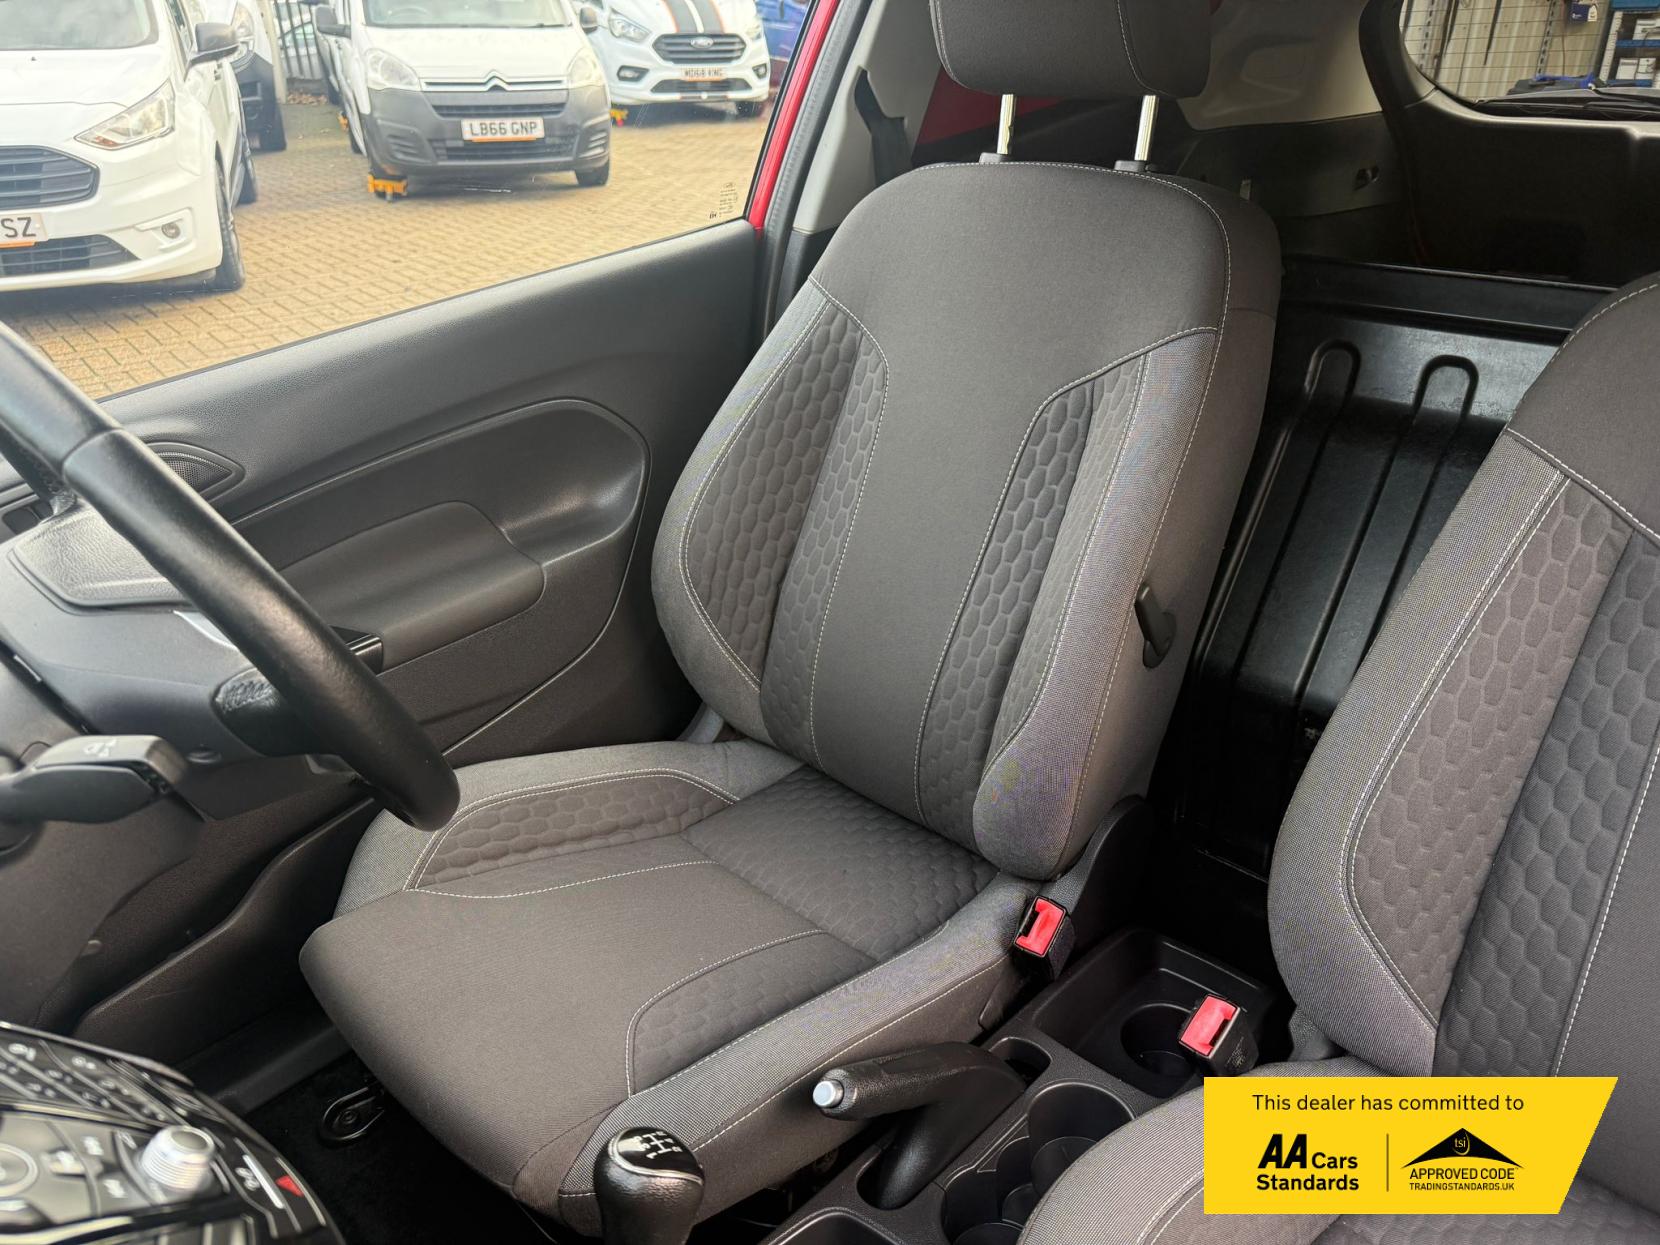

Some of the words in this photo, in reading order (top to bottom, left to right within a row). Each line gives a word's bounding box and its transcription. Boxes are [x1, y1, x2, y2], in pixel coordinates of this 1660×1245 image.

[469, 122, 507, 136] LB66
[511, 121, 537, 135] GNP
[1, 216, 37, 238] SZ
